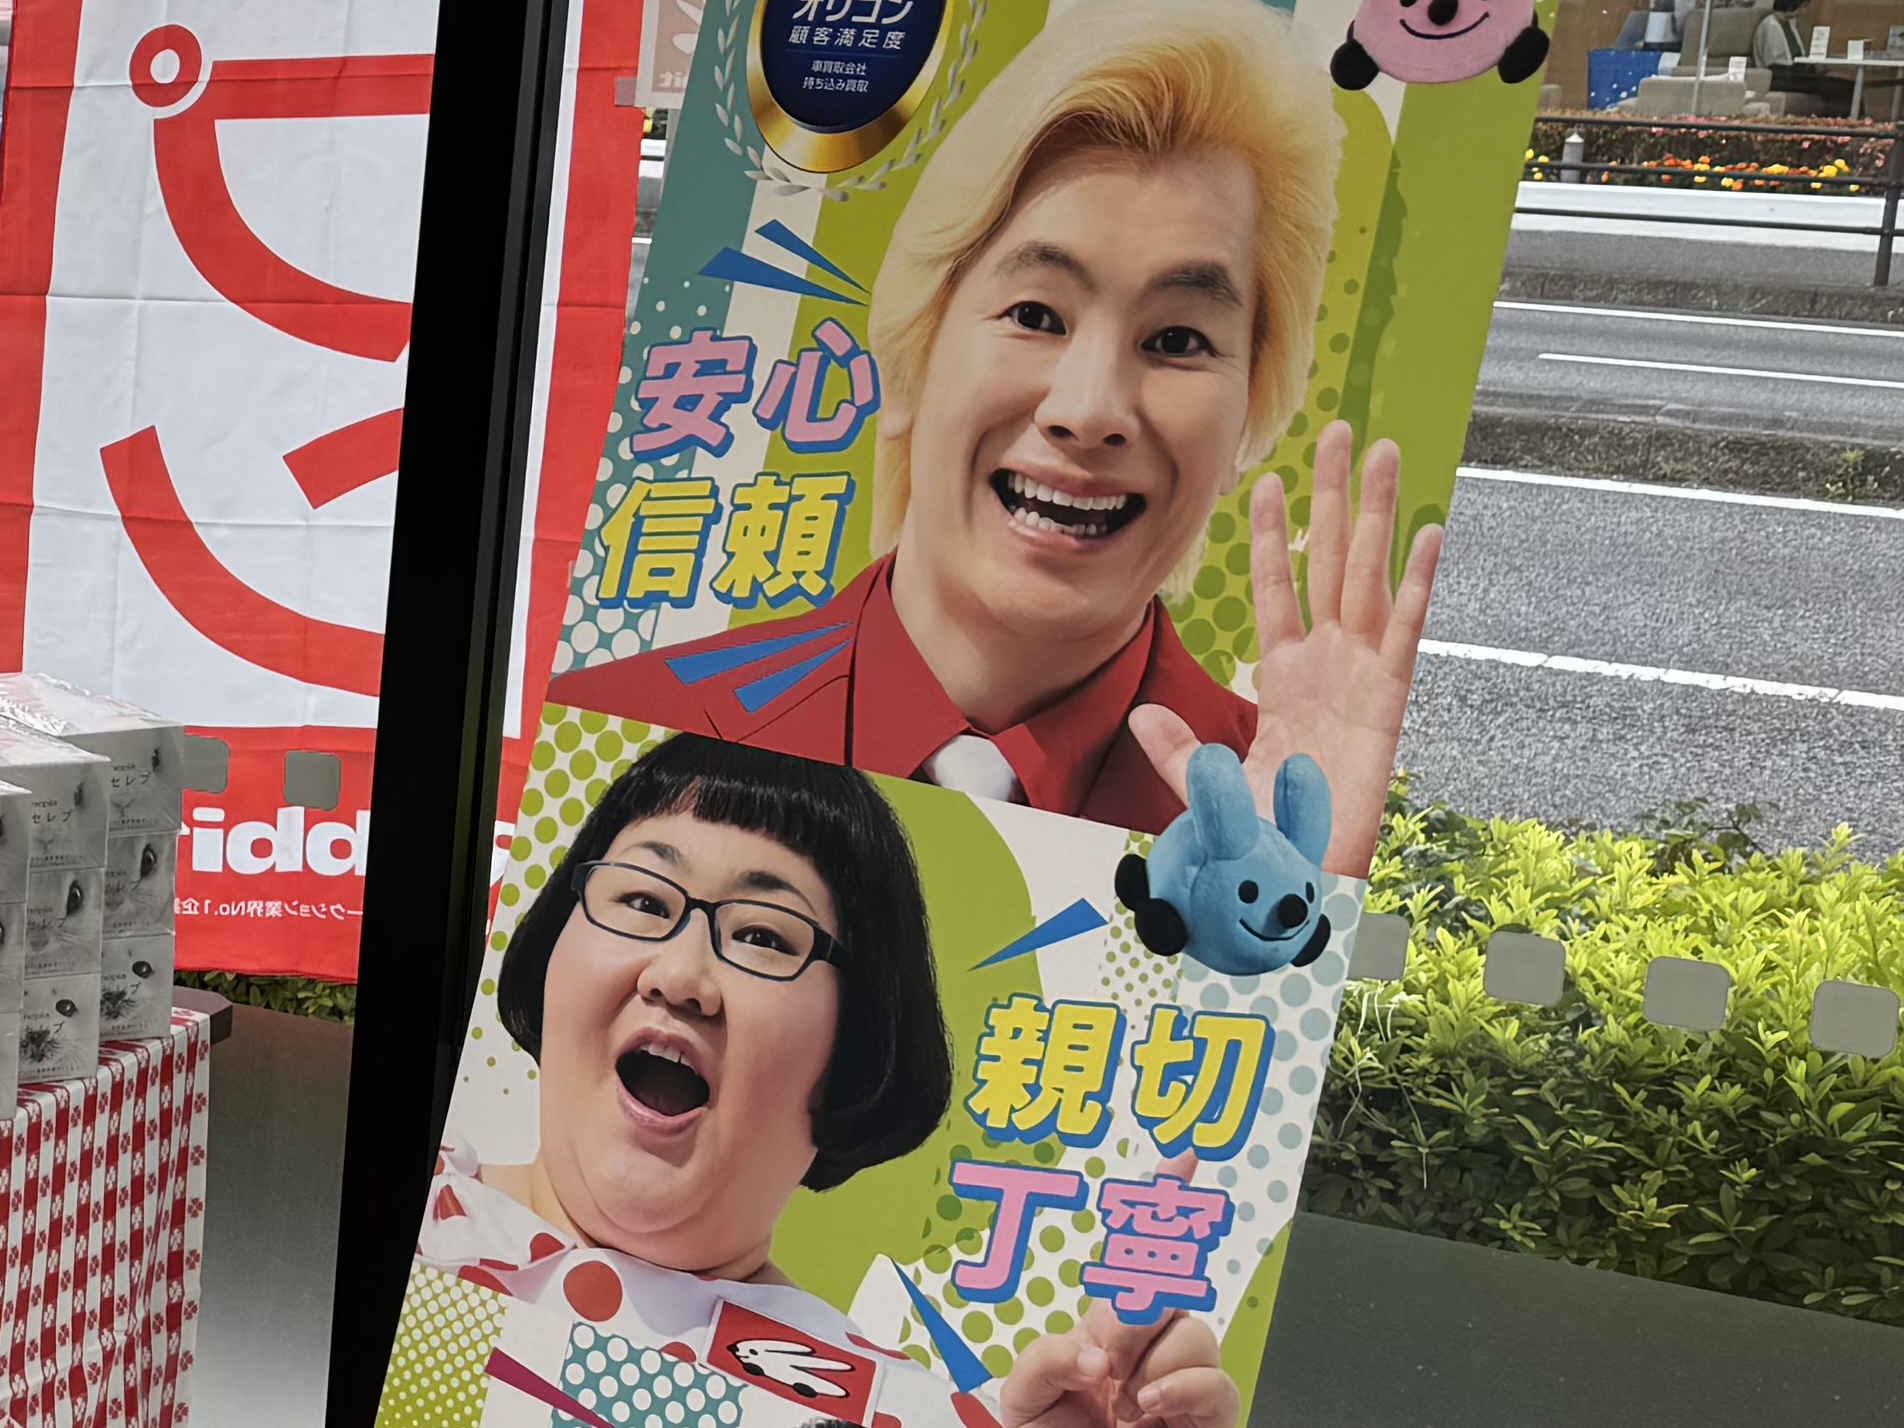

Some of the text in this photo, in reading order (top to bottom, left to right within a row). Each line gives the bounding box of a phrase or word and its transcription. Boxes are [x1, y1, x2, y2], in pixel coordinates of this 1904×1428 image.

[788, 25, 906, 51] 顧客満足度
[631, 318, 882, 460] 安心
[598, 471, 856, 609] 信頼
[966, 994, 1274, 1161] 親切
[951, 1160, 1236, 1325] 丁寧
